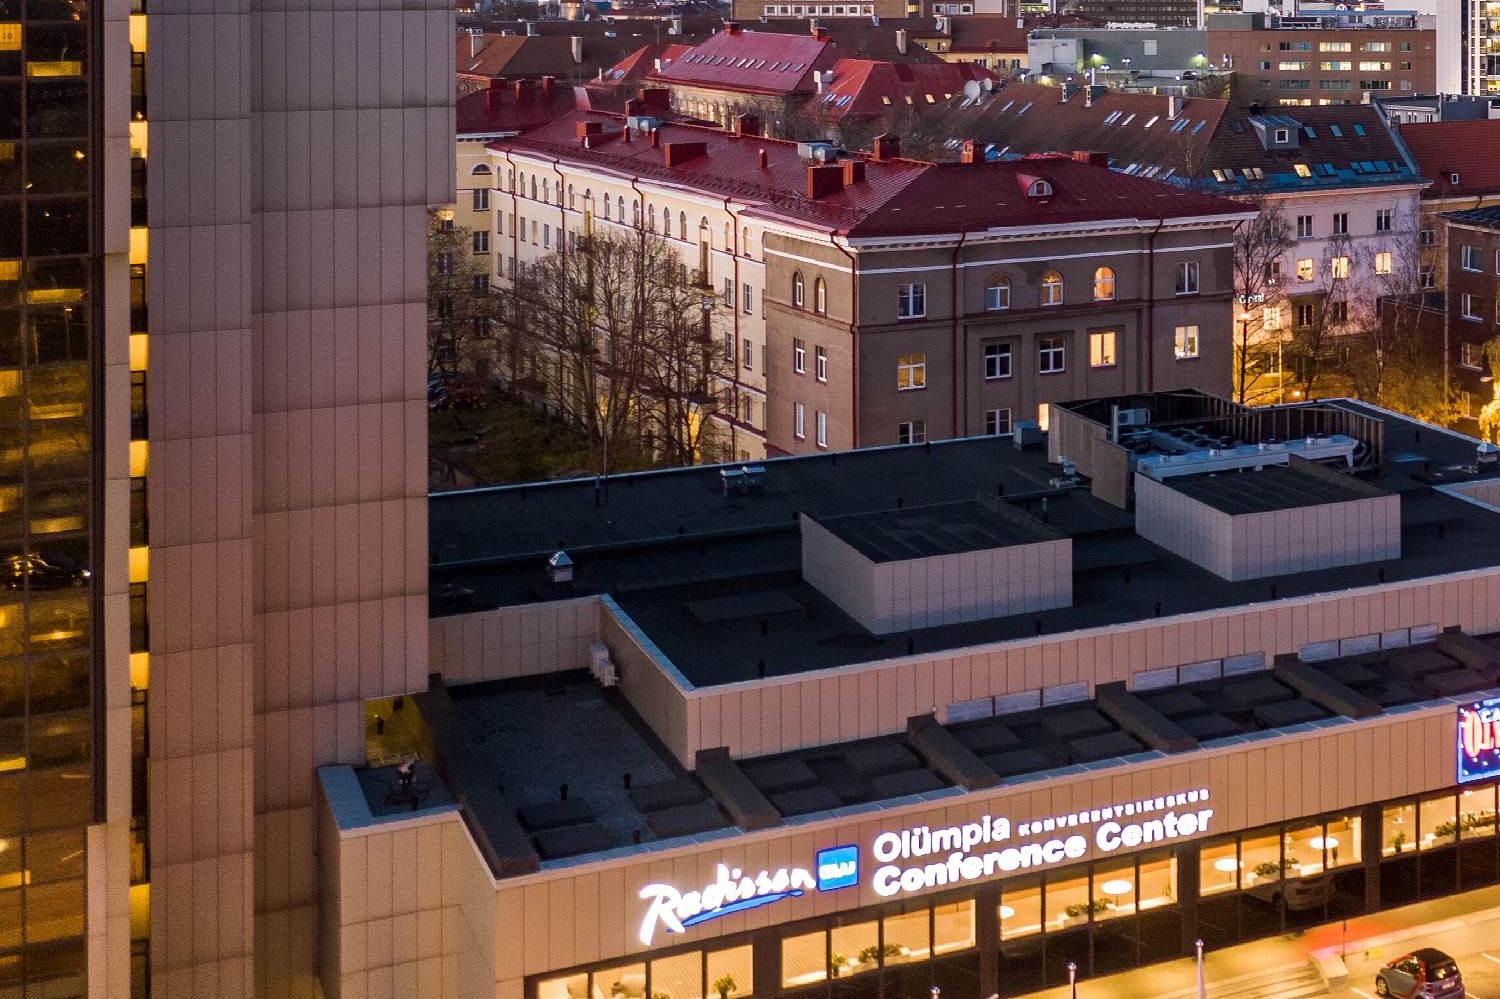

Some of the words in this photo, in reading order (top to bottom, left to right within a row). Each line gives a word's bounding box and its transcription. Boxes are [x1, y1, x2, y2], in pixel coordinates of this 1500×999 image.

[872, 835, 1087, 896] Conference
[1096, 808, 1214, 852] Center
[873, 815, 1012, 863] Olümpia
[1018, 789, 1210, 837] KONVERENTSIKESKUS
[639, 863, 817, 945] Radisson
